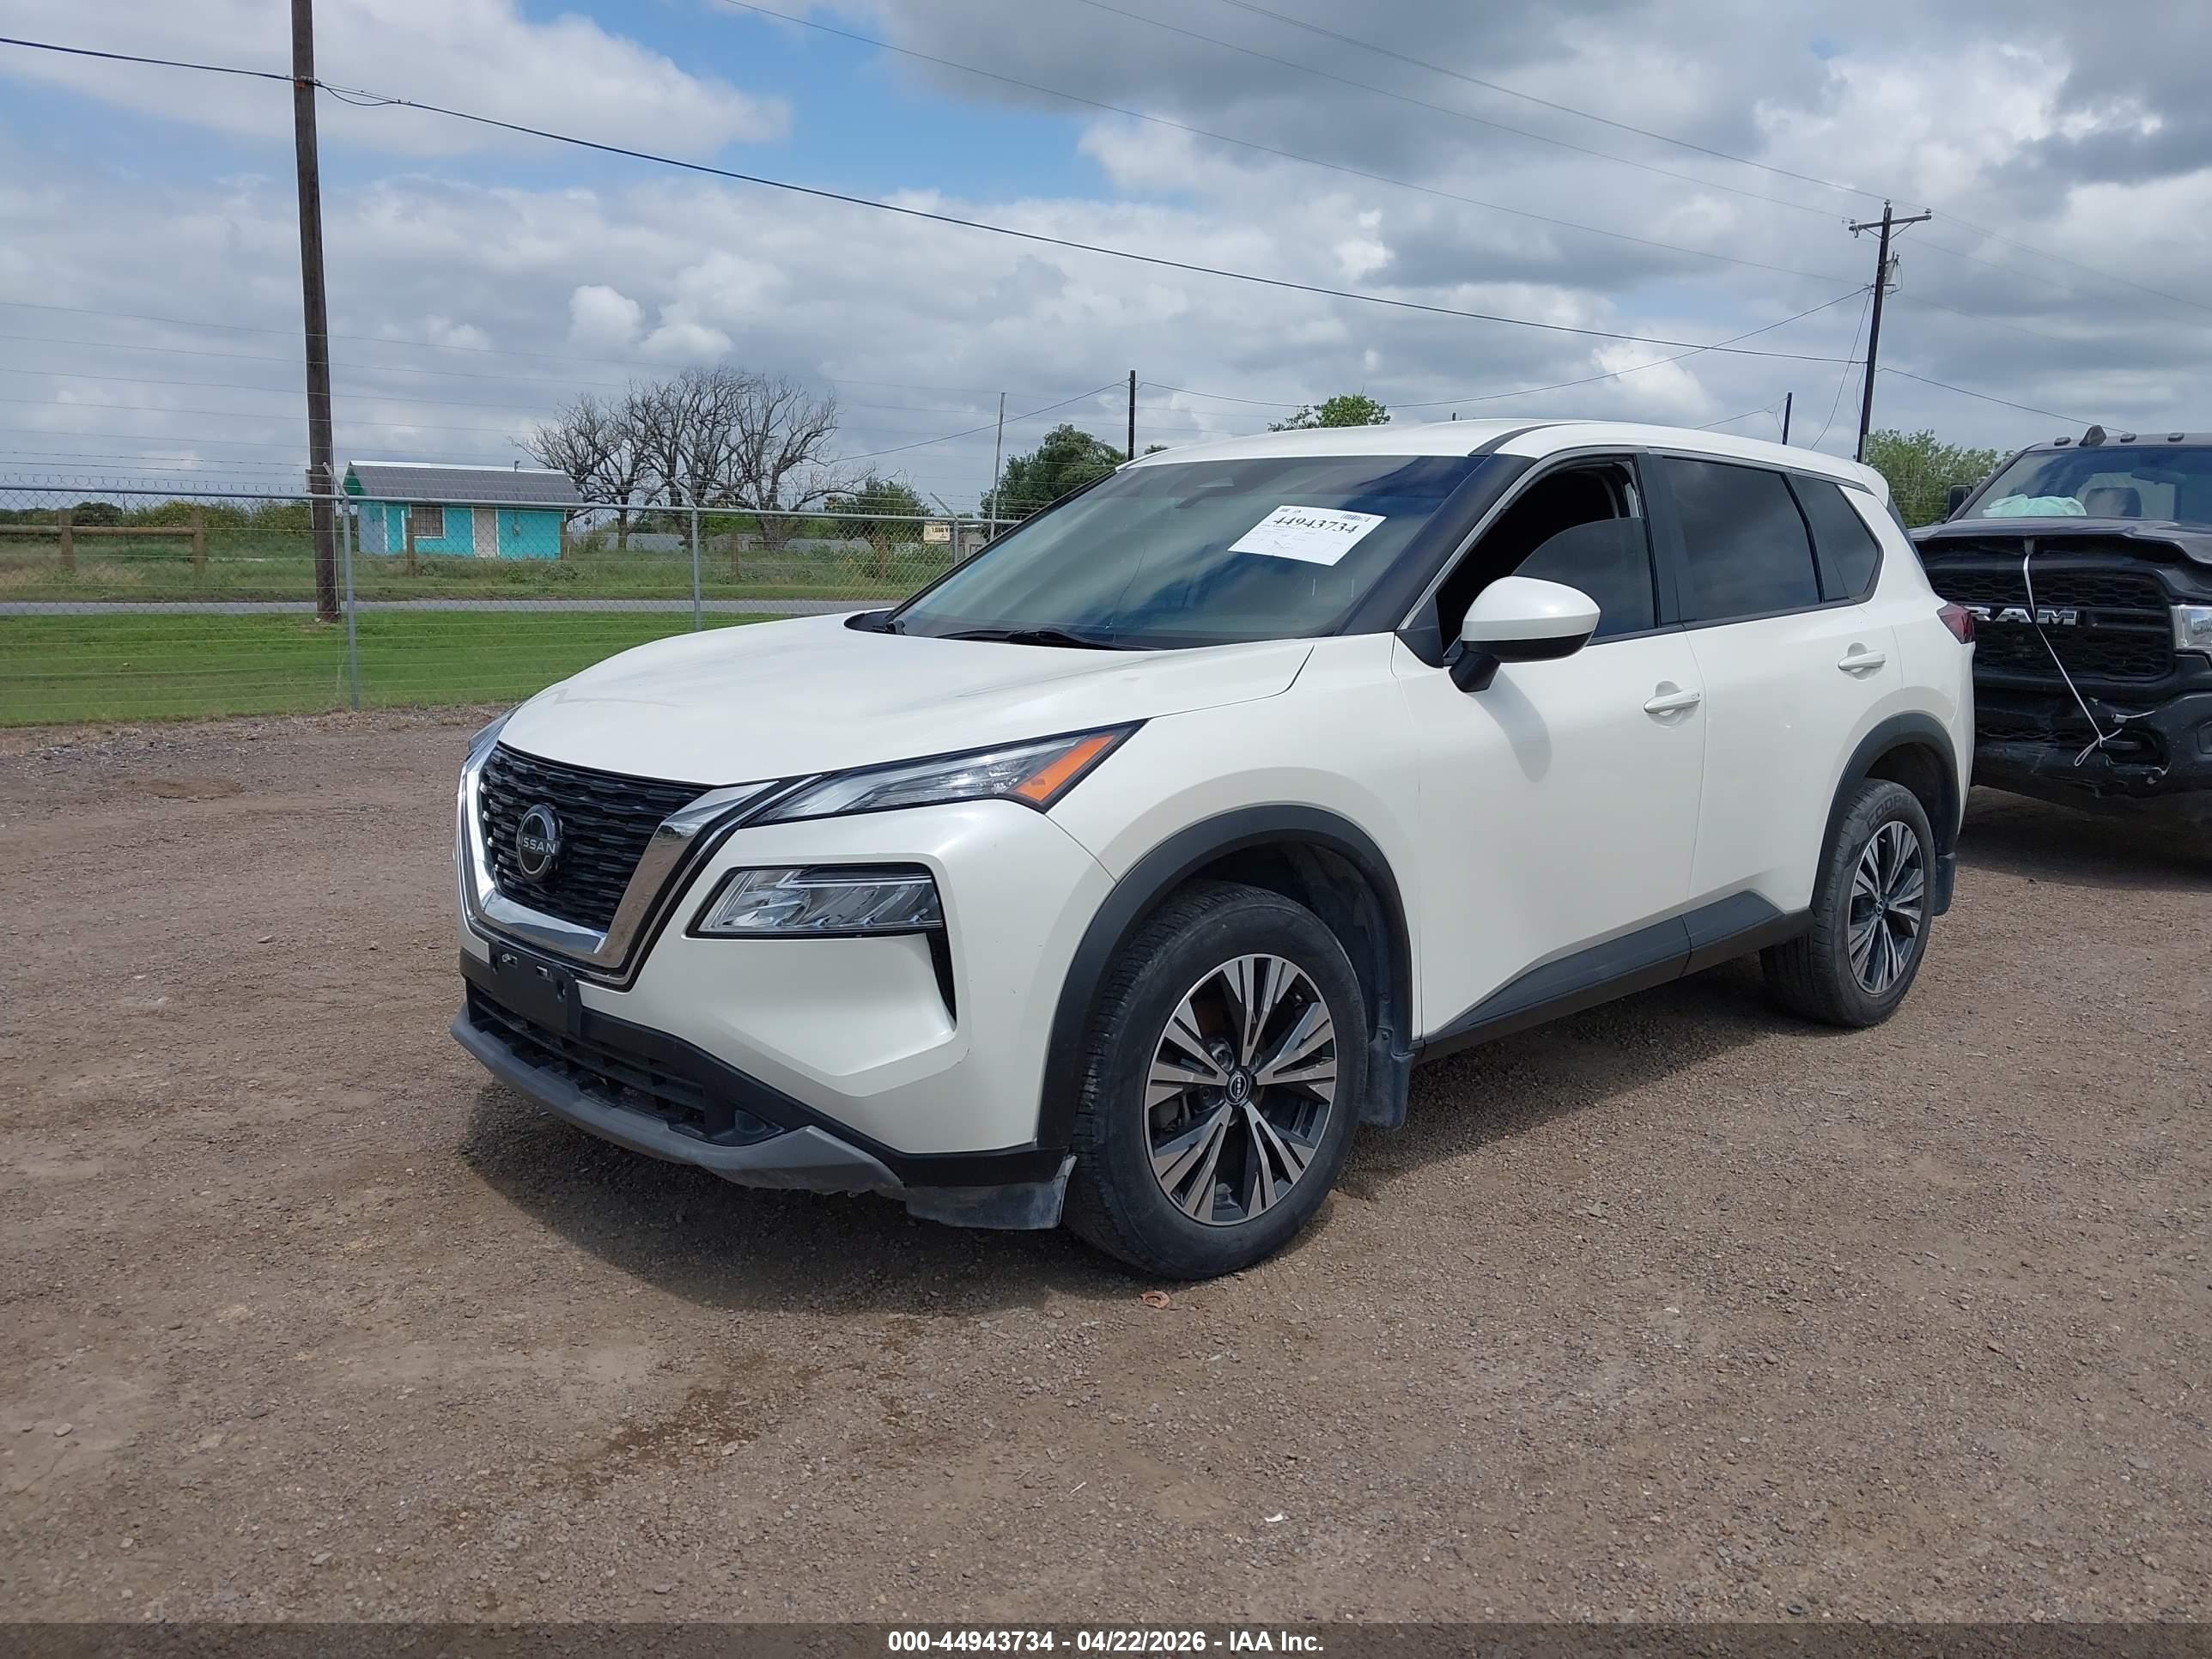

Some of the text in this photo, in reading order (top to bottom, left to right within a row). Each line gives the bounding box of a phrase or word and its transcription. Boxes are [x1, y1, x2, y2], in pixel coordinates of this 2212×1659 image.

[1273, 516, 1359, 533] 44943734
[1964, 605, 2077, 625] RAM
[1867, 794, 1915, 831] COOPE
